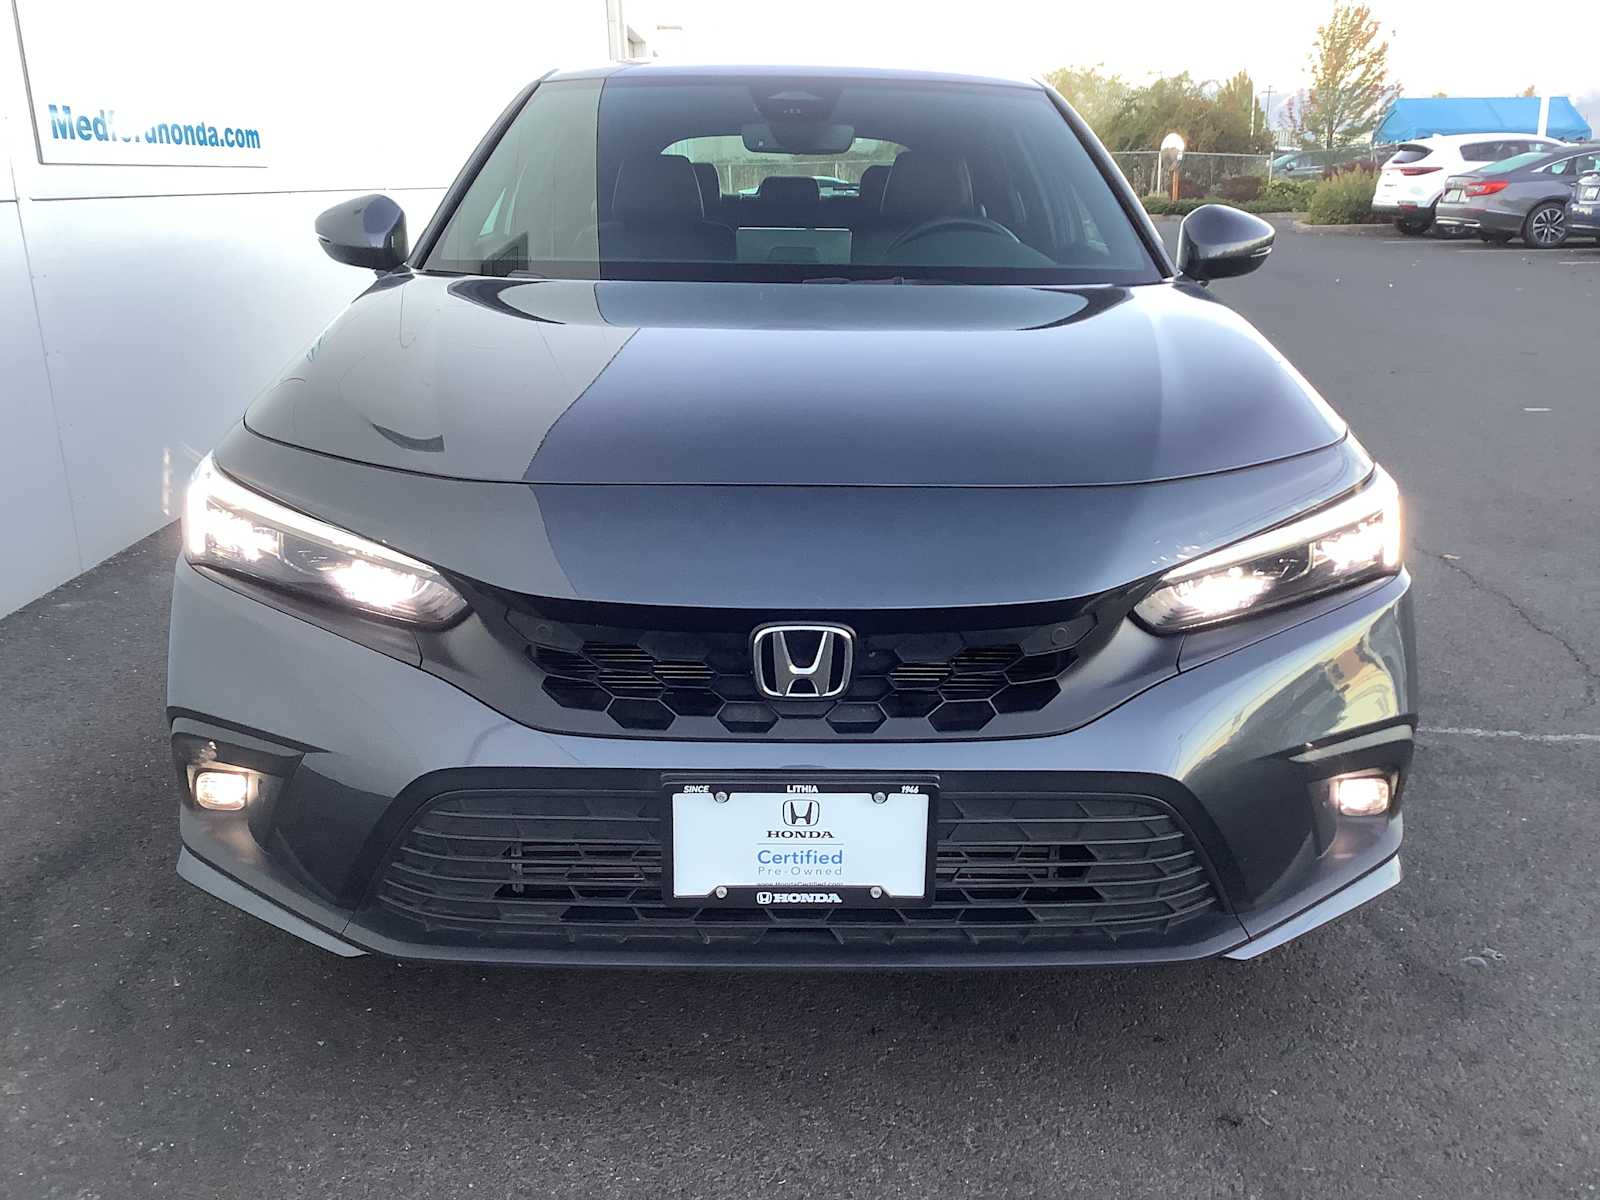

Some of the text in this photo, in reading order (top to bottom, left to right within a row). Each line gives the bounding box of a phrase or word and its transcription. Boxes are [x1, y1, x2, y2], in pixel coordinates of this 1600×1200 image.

[48, 104, 261, 149] Meddhonda.com
[683, 785, 710, 793] SINCE
[786, 784, 819, 793] LITHIA
[767, 830, 834, 839] HONDA
[757, 850, 842, 864] Certified
[758, 866, 842, 876] Pre-Owned
[773, 893, 842, 903] HONDA
